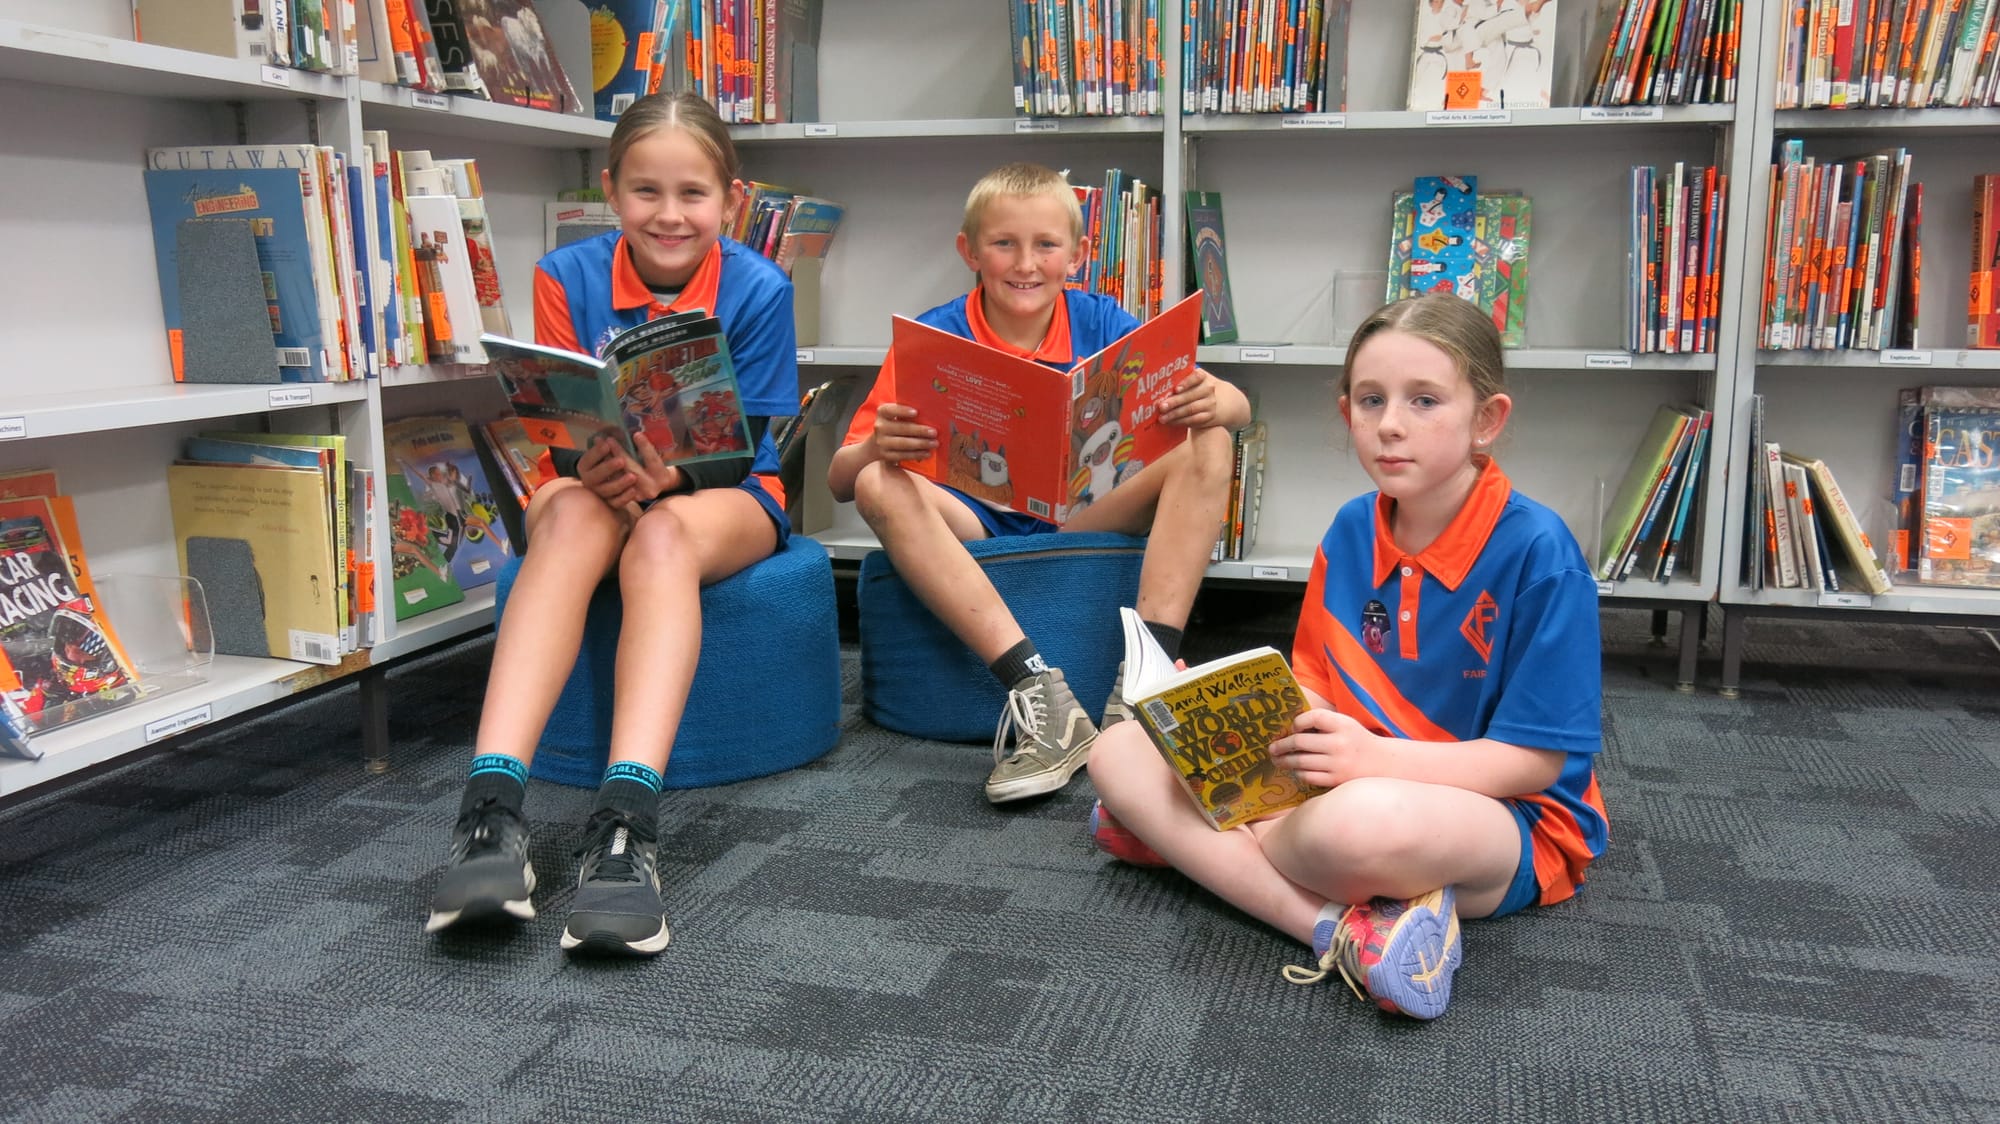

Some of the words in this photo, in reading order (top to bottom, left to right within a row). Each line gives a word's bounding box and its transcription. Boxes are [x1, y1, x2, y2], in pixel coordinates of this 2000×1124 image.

[1818, 17, 1829, 60] HISTORY
[271, 71, 283, 81] Cars
[765, 30, 776, 104] INSTRUMENTS
[1489, 113, 1506, 121] Sports
[153, 149, 311, 171] CUTAWAY
[195, 193, 258, 215] ENGINEERING
[1689, 207, 1700, 239] LIBRARY
[1135, 353, 1190, 400] Alpacas
[1611, 358, 1628, 366] Sports
[1829, 486, 1848, 515] FLAGS
[1777, 508, 1790, 541] FLAGS
[1205, 666, 1283, 698] Walliams
[151, 719, 177, 736] Awesome
[177, 710, 208, 728] Engineering
[1169, 686, 1304, 745] WORLD'S
